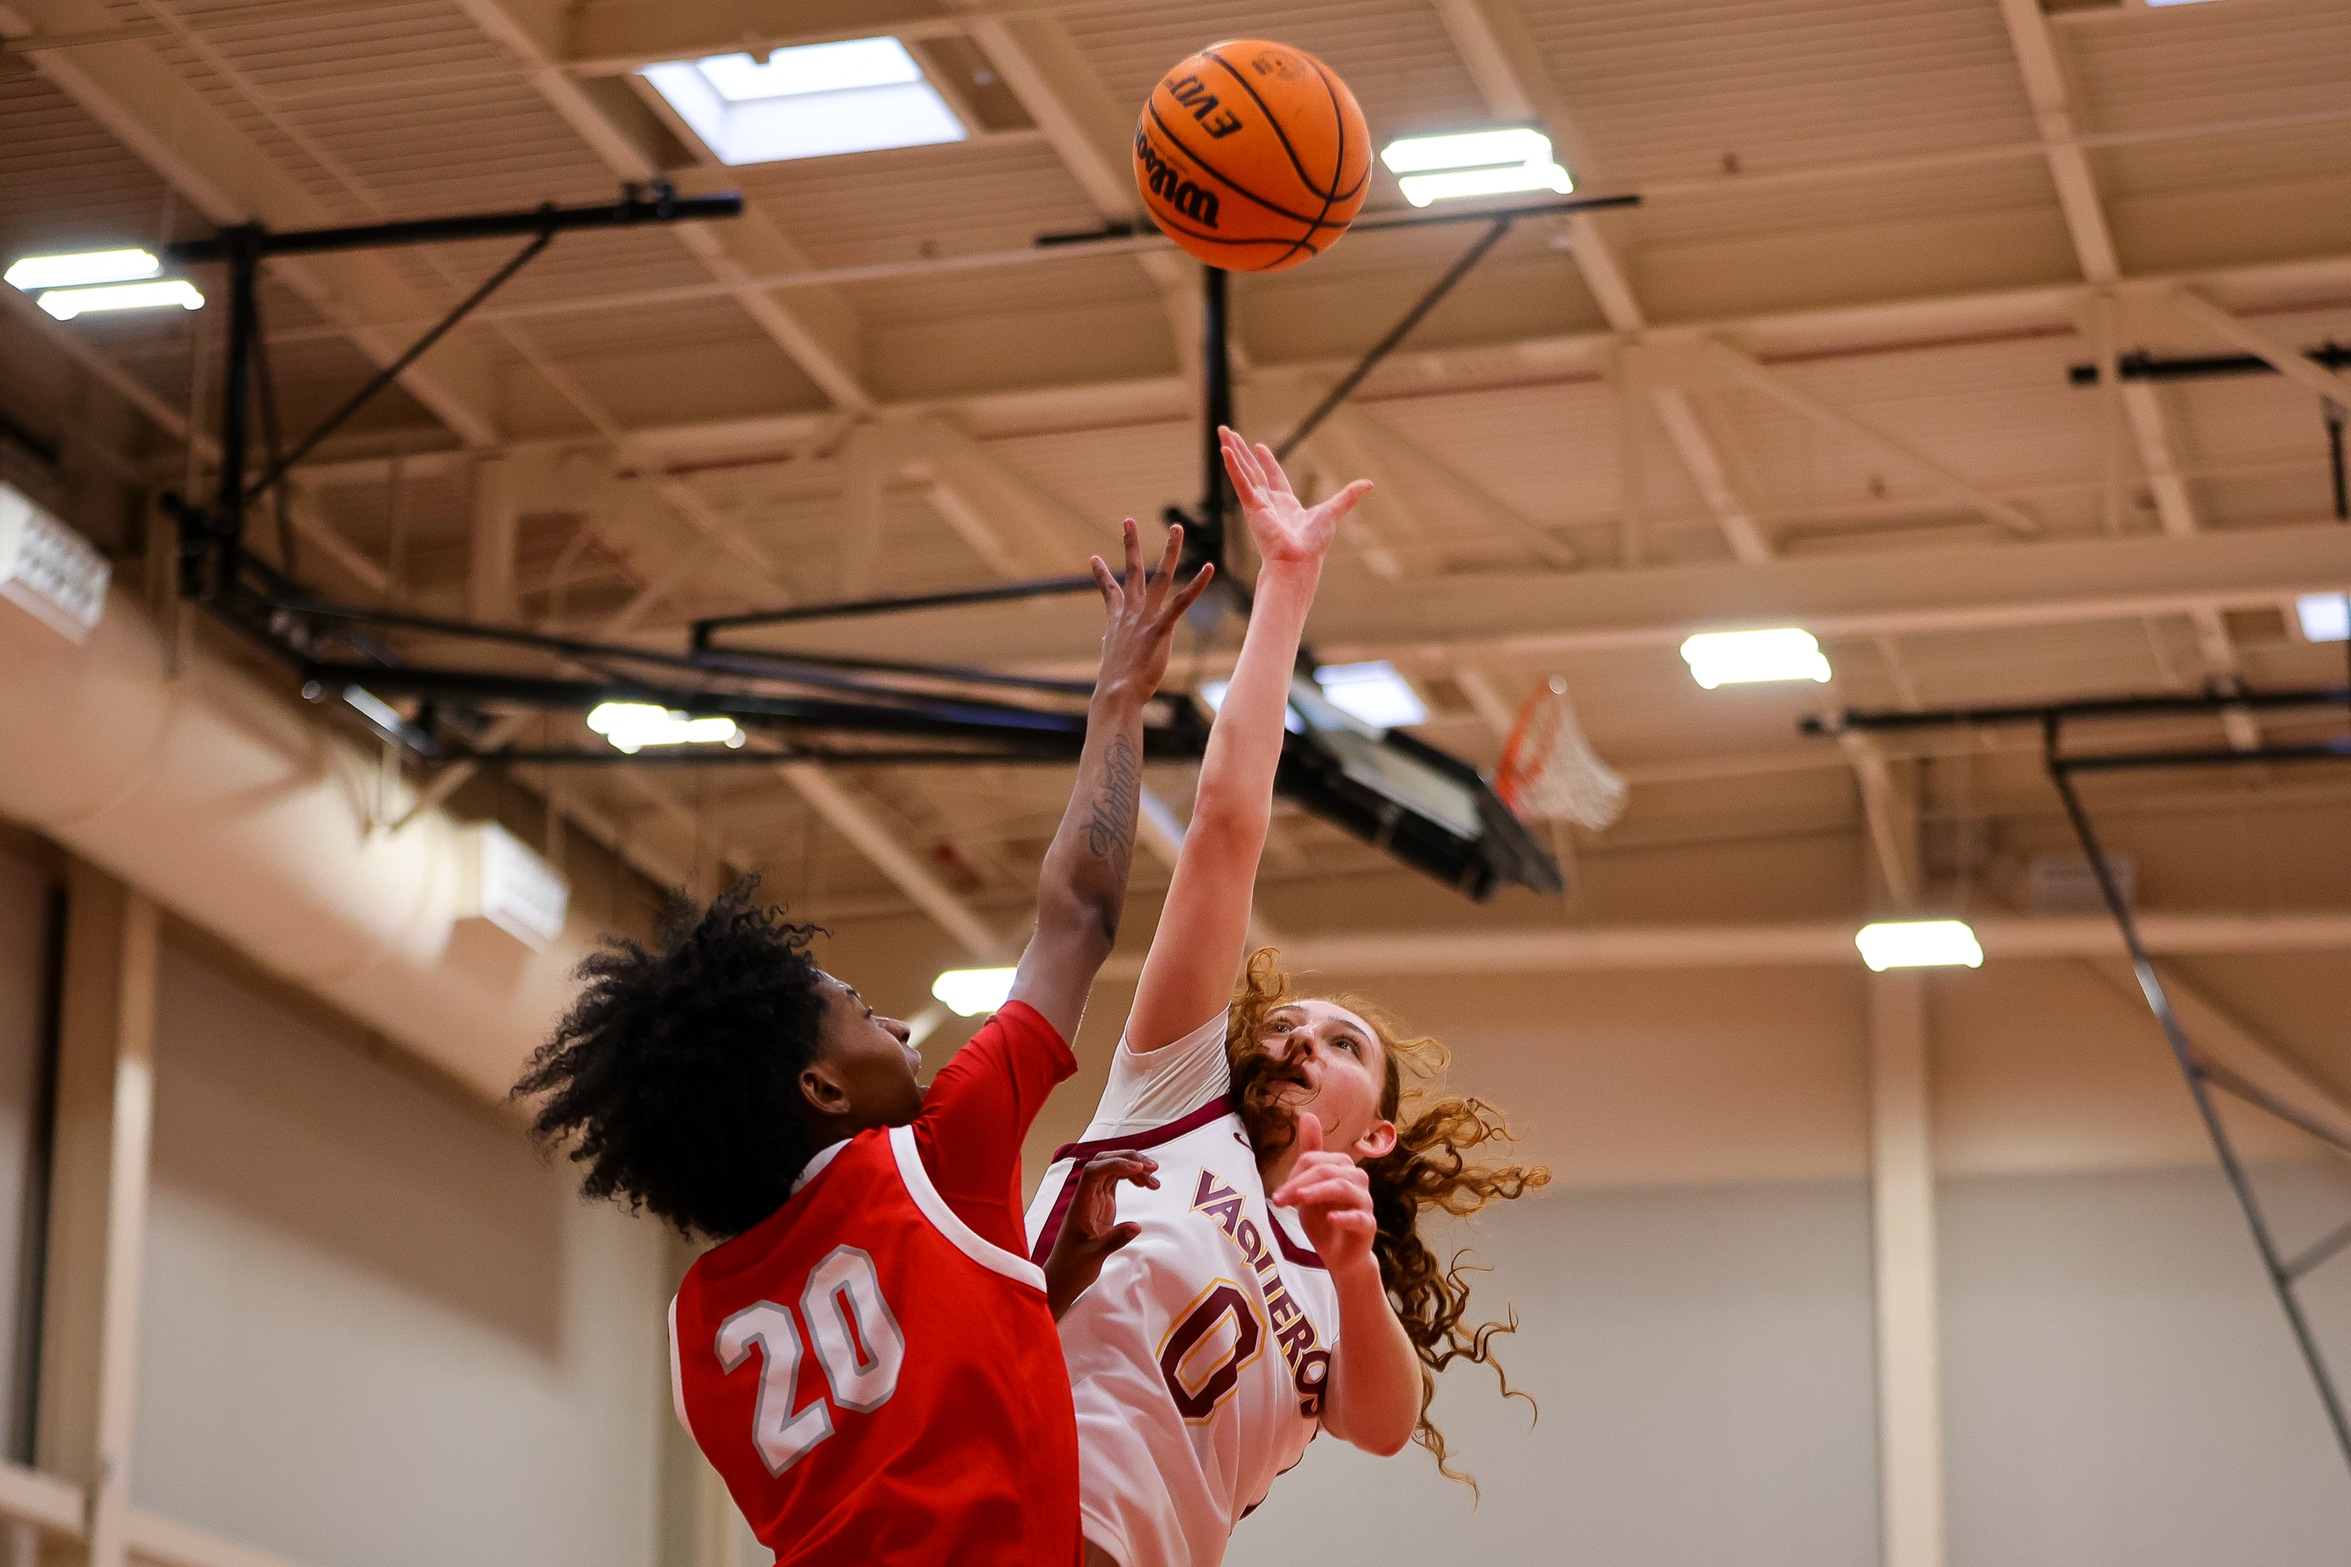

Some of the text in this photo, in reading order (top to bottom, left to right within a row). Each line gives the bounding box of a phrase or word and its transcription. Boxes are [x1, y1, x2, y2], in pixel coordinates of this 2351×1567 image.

[1170, 76, 1243, 138] EVO
[714, 1243, 906, 1479] 20
[1155, 1277, 1267, 1426] 0
